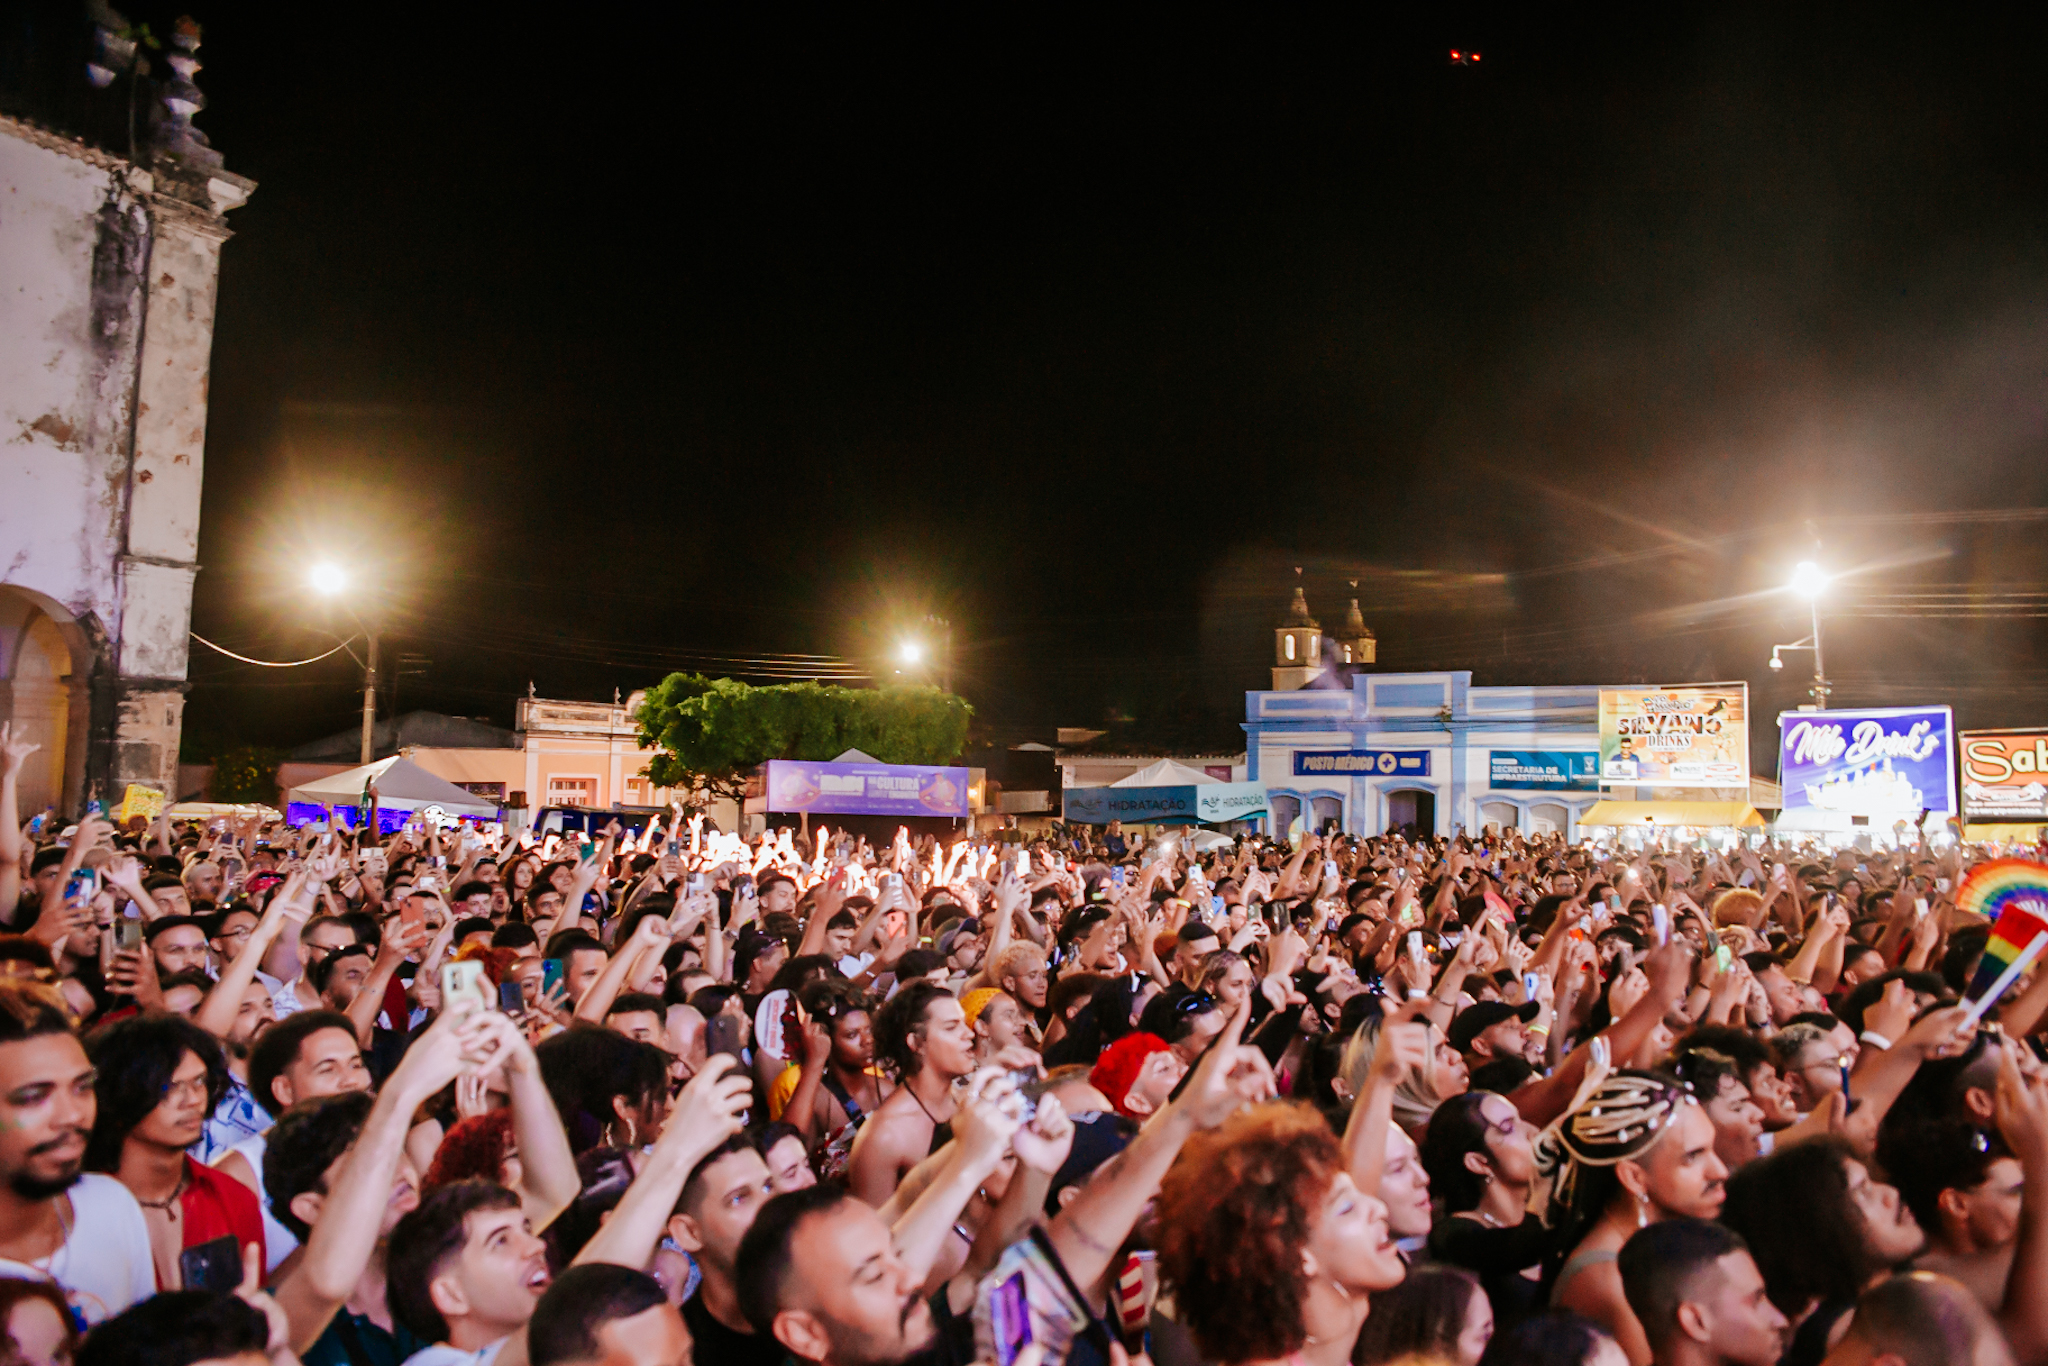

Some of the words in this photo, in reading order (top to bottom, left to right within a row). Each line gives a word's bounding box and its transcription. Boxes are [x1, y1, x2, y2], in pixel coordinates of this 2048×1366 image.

[1648, 735, 1691, 747] DRINKS
[1303, 756, 1334, 770] POSTO
[1335, 754, 1375, 771] MÉDICO
[1492, 765, 1544, 774] SECRETARIA
[1545, 766, 1559, 775] DE
[877, 776, 919, 790] CULTURA
[1491, 773, 1568, 783] INFRAESTRUTURA
[1108, 797, 1187, 812] HIDRATAÇÃO
[1223, 793, 1264, 808] HIDRATAÇÃO
